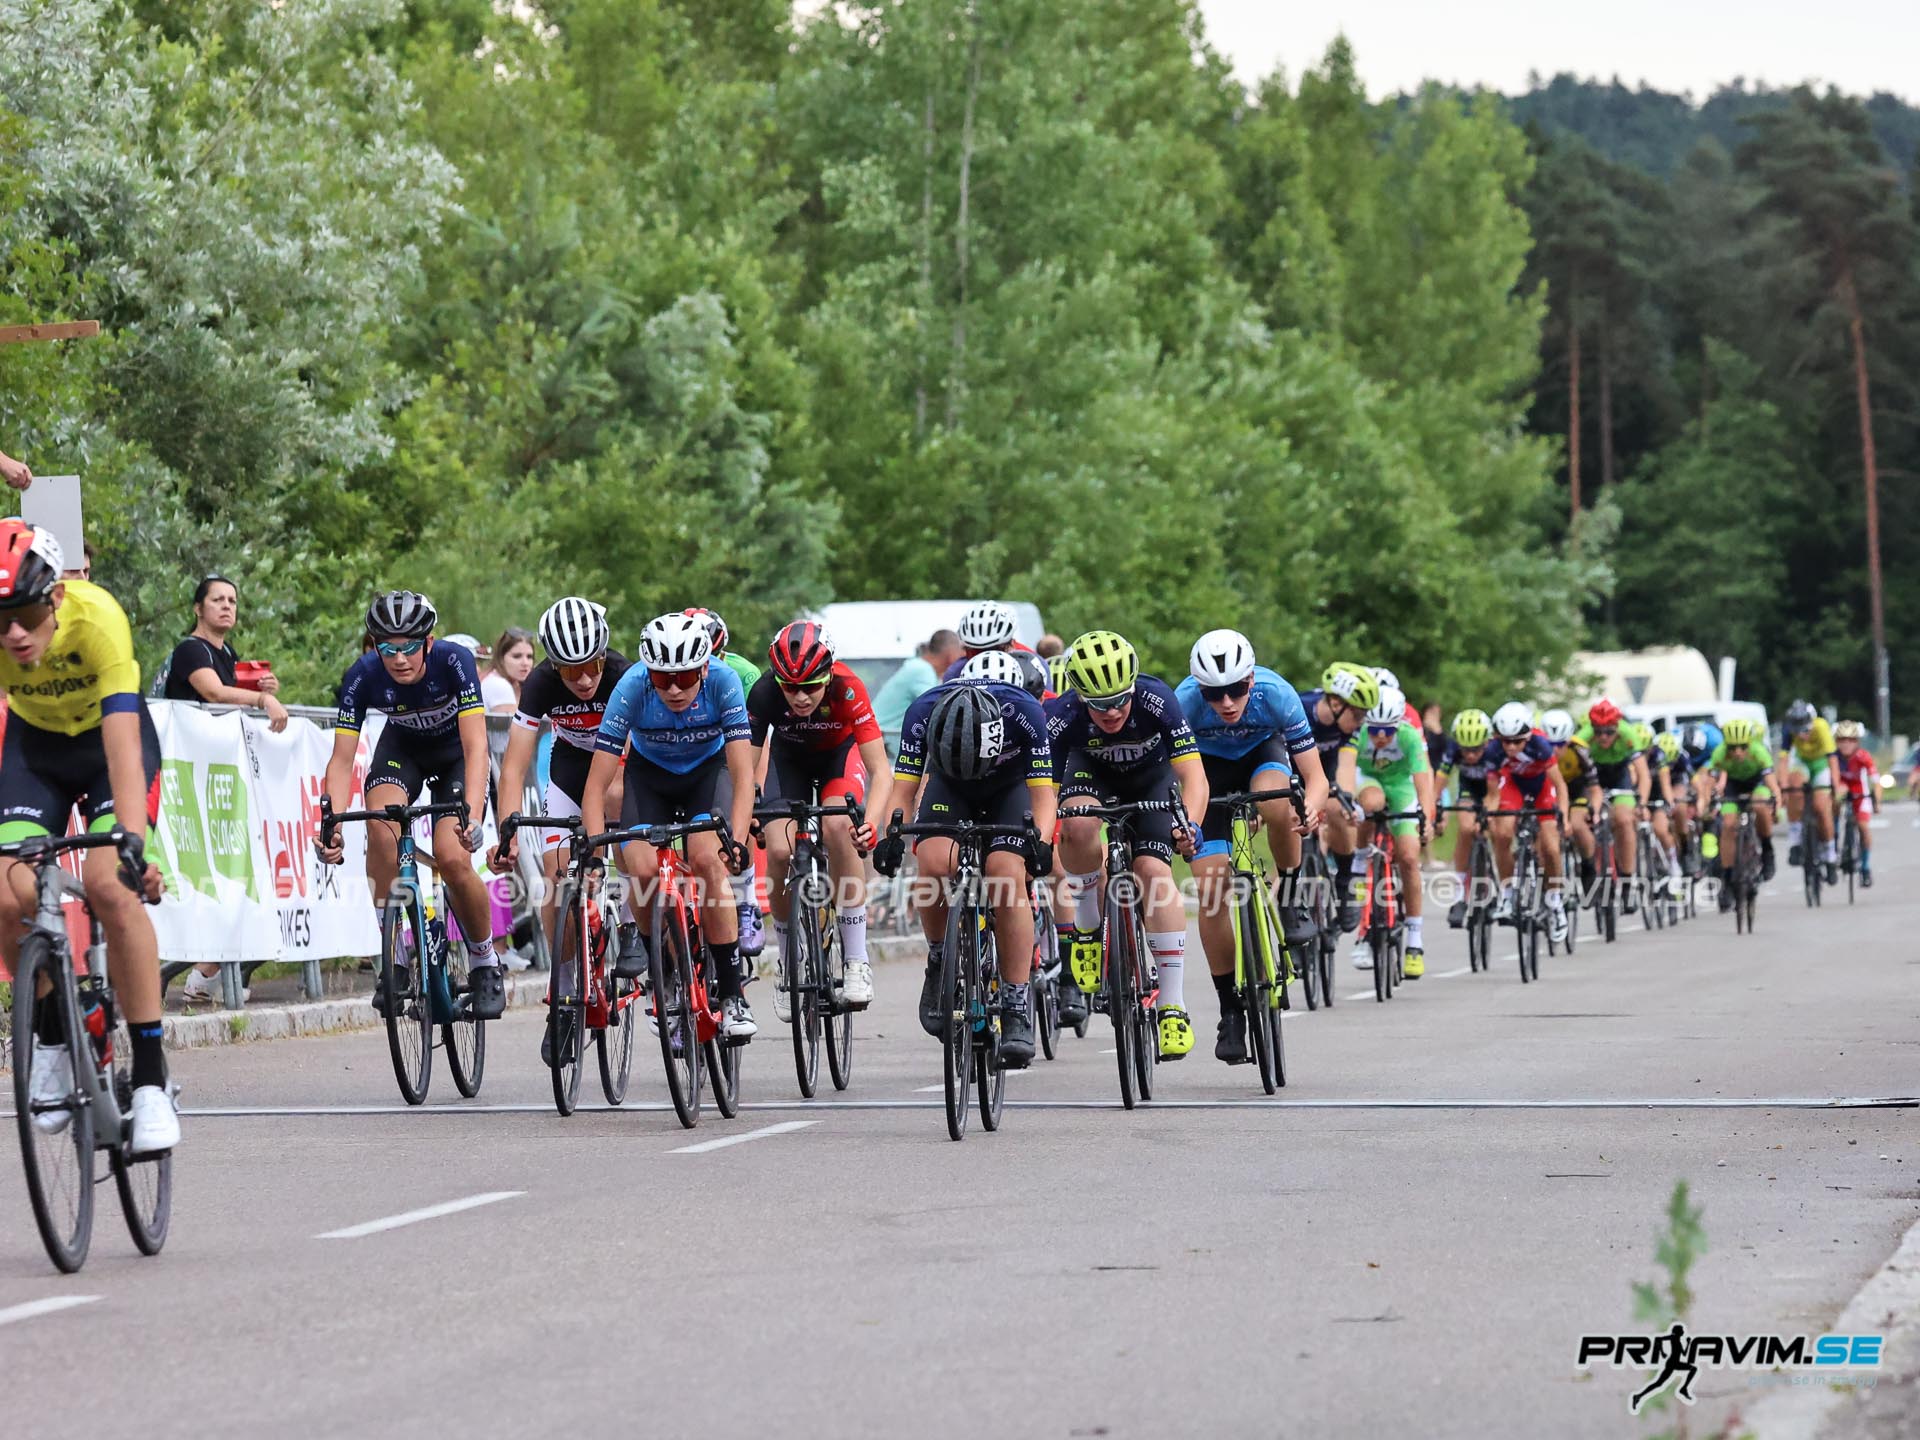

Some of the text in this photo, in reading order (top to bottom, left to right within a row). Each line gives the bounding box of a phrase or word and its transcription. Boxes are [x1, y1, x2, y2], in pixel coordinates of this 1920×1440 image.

[1143, 700, 1163, 718] LOVE
[1146, 692, 1165, 709] FEEL
[1015, 712, 1038, 739] Plume
[1170, 725, 1191, 738] tus
[901, 738, 921, 754] tus
[988, 721, 1002, 756] 243
[1031, 745, 1051, 756] tus
[214, 774, 234, 811] FEE
